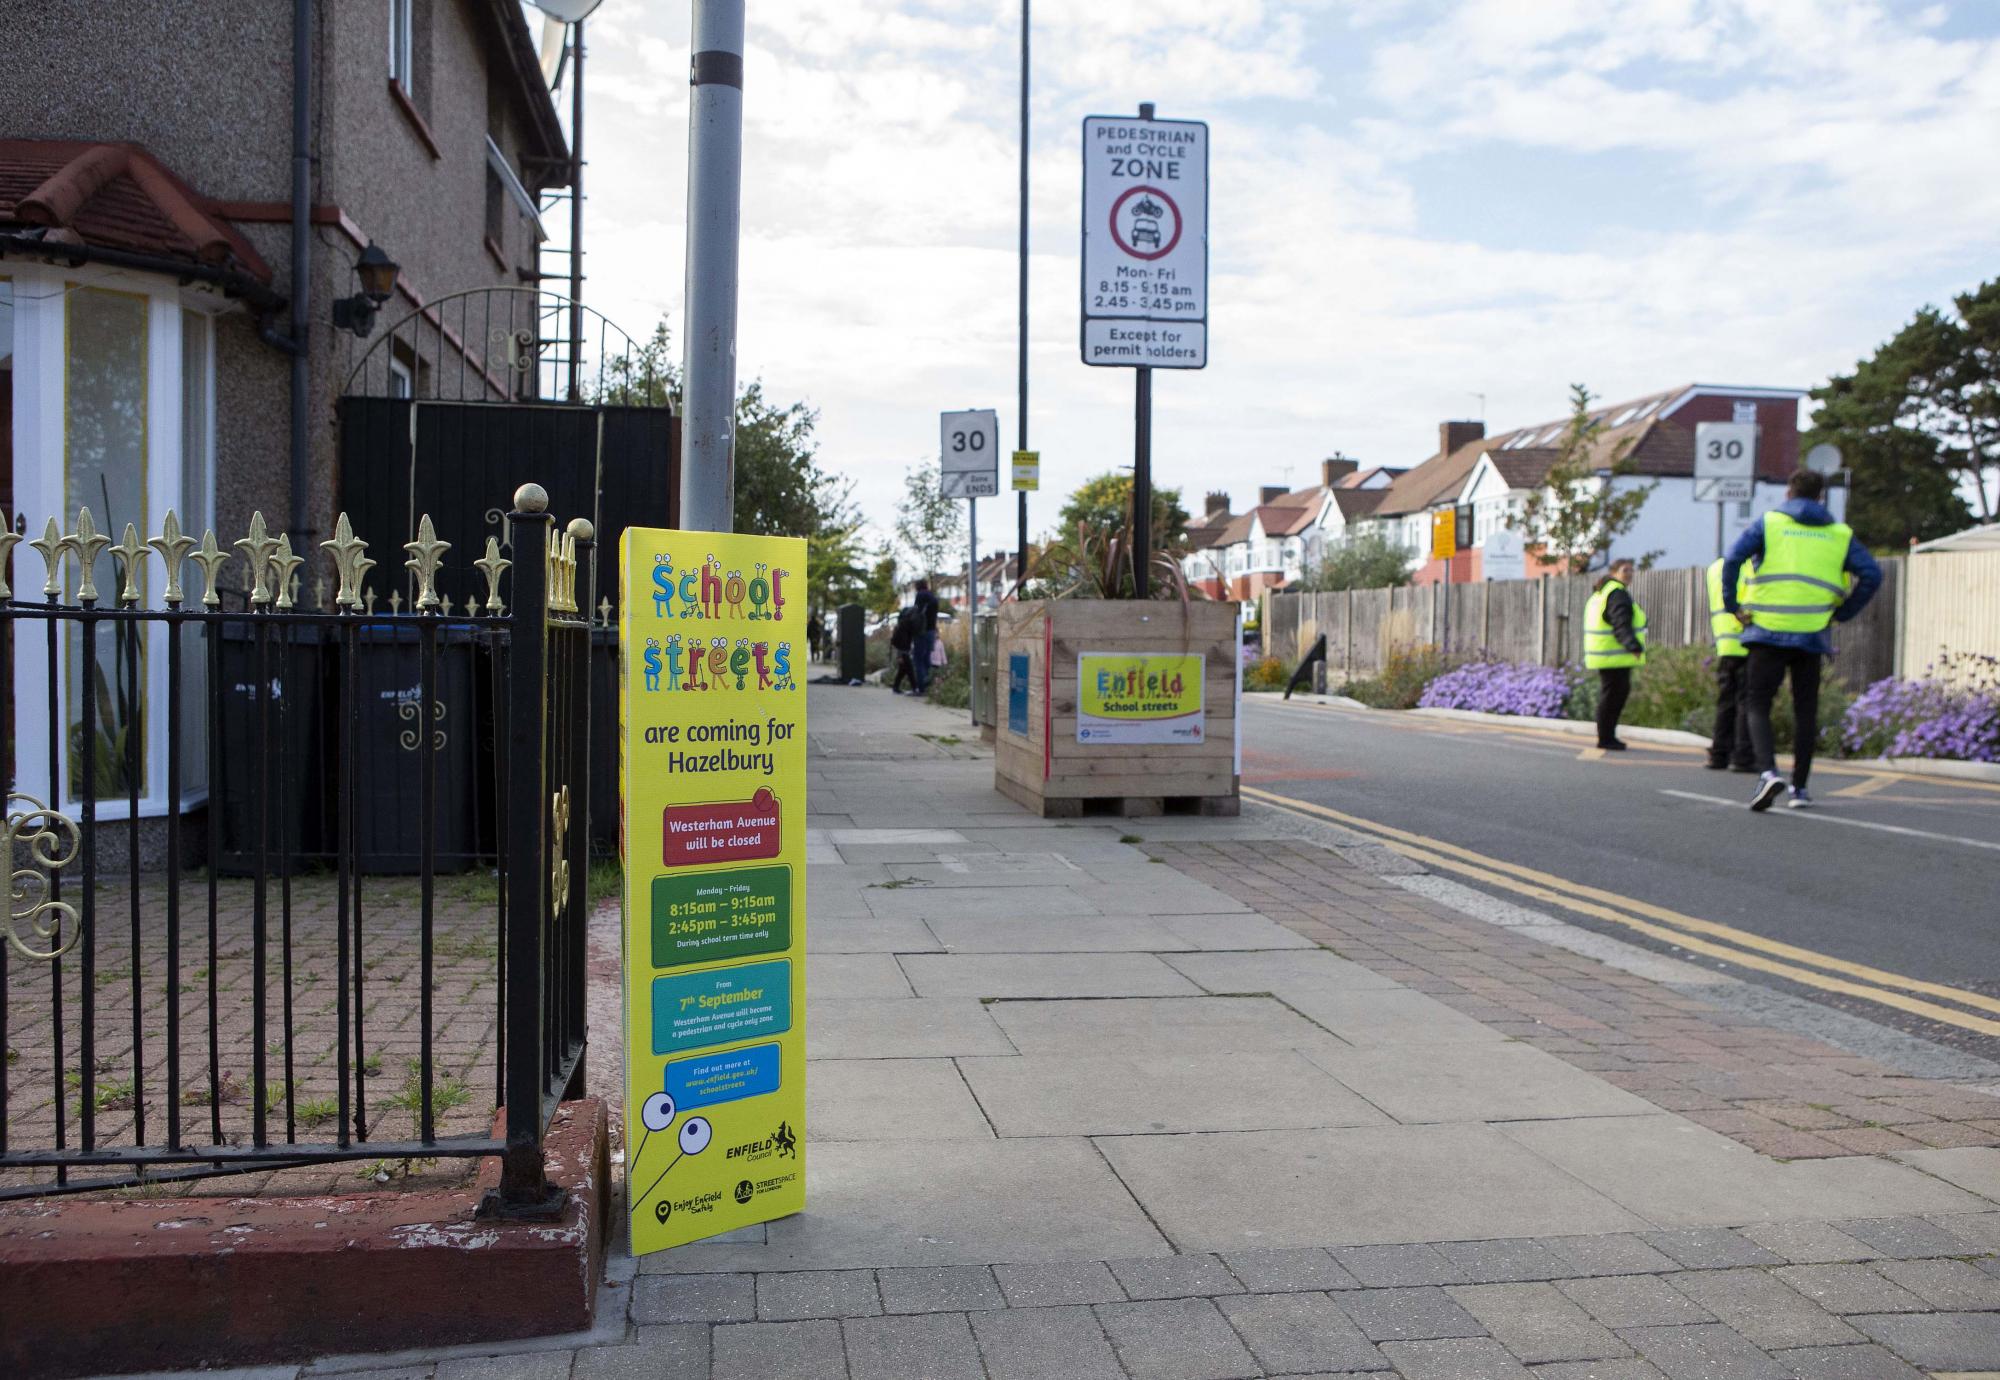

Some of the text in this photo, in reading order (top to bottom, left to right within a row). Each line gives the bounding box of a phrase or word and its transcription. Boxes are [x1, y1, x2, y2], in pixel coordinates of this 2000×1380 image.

[1096, 127, 1195, 143] PEDESTRIAN
[1106, 143, 1186, 158] and CYCLE
[1111, 159, 1180, 180] ZONE
[1116, 266, 1147, 278] Mon
[1158, 268, 1176, 280] Fri
[1100, 281, 1129, 293] 8.15
[1141, 281, 1168, 295] 9.15
[1171, 286, 1192, 296] am
[1094, 296, 1128, 308] 2.45
[1140, 297, 1172, 310] 3.45
[1175, 302, 1196, 312] pm
[1110, 328, 1182, 342] Except for
[1094, 344, 1196, 358] permit holders
[952, 430, 985, 452] 30
[1708, 440, 1744, 460] 30
[966, 484, 994, 494] ENDS
[652, 556, 788, 618] School
[644, 636, 795, 689] streets
[1097, 667, 1184, 698] Enfield
[1104, 702, 1178, 712] School streets
[644, 718, 795, 746] are coming for
[668, 749, 774, 775] Hazelbury
[670, 816, 776, 832] Westerham Avenue
[686, 833, 761, 850] will be closed
[696, 886, 722, 896] Monday
[730, 884, 750, 892] Friday
[670, 902, 716, 917] 8:15am
[731, 896, 775, 910] 9:15am
[668, 919, 716, 935] 2:45pm
[731, 912, 776, 927] 3:45pm
[676, 930, 768, 948] During school term time only
[716, 981, 732, 989] From
[680, 988, 764, 1012] 7th September
[674, 1006, 772, 1027] Westerham Avenue will become
[678, 1025, 712, 1038] pedestrian
[714, 1022, 726, 1030] and
[727, 1020, 743, 1030] cycle
[744, 1017, 758, 1026] only
[694, 1066, 709, 1076] Find
[711, 1064, 723, 1072] out
[724, 1062, 742, 1070] more
[699, 1081, 746, 1096] schoolstreets
[726, 1139, 772, 1159] ENFIELD
[746, 1150, 772, 1162] Council
[764, 1185, 782, 1193] LONDON
[674, 1199, 694, 1212] Enjoy
[691, 1203, 713, 1214] Safely
